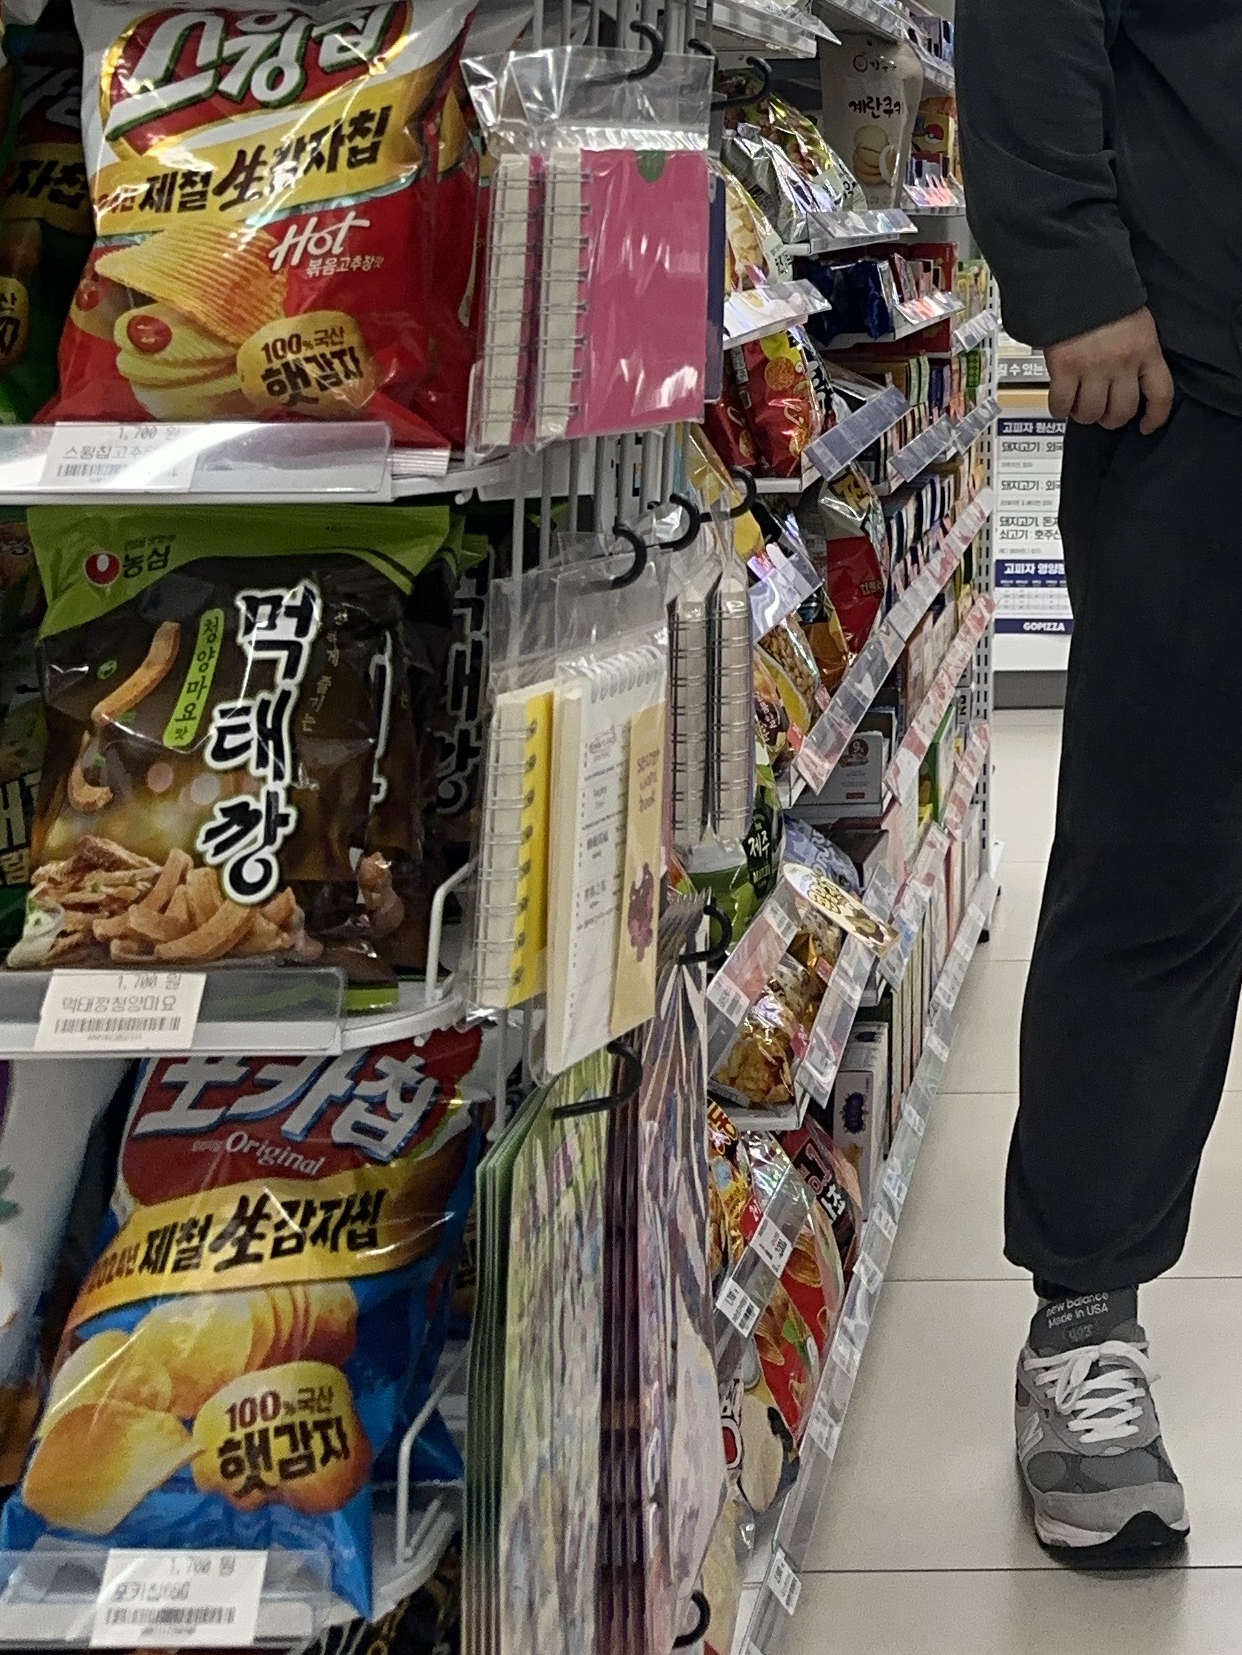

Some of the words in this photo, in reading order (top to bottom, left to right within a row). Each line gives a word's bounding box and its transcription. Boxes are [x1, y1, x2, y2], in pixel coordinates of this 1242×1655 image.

[139, 169, 213, 214] 제철
[268, 210, 371, 271] Hot
[306, 255, 385, 278] 볶음고추장맛
[313, 325, 345, 347] 국산
[260, 345, 365, 407] 햇감자
[118, 426, 158, 441] 1,700
[1002, 422, 1033, 435] 고피자
[1001, 441, 1040, 453] 돼지고기
[1001, 480, 1040, 492] 돼지고기
[999, 529, 1029, 541] 쇠고기
[123, 545, 172, 579] 농심
[1003, 562, 1035, 576] 고피자
[1022, 621, 1066, 633] GOPIZZA
[173, 616, 220, 741] 청양마요맛
[199, 581, 321, 903] 먹태깡
[117, 974, 158, 991] 1,700
[225, 1129, 326, 1177] Original
[138, 1213, 213, 1275] 제철
[1045, 1302, 1065, 1318] new
[1065, 1291, 1109, 1309] balance
[1048, 1312, 1073, 1329] Made
[1086, 1302, 1109, 1316] USA
[226, 1389, 297, 1433] 100%
[297, 1384, 334, 1414] 국산
[217, 1415, 350, 1499] 햇감자
